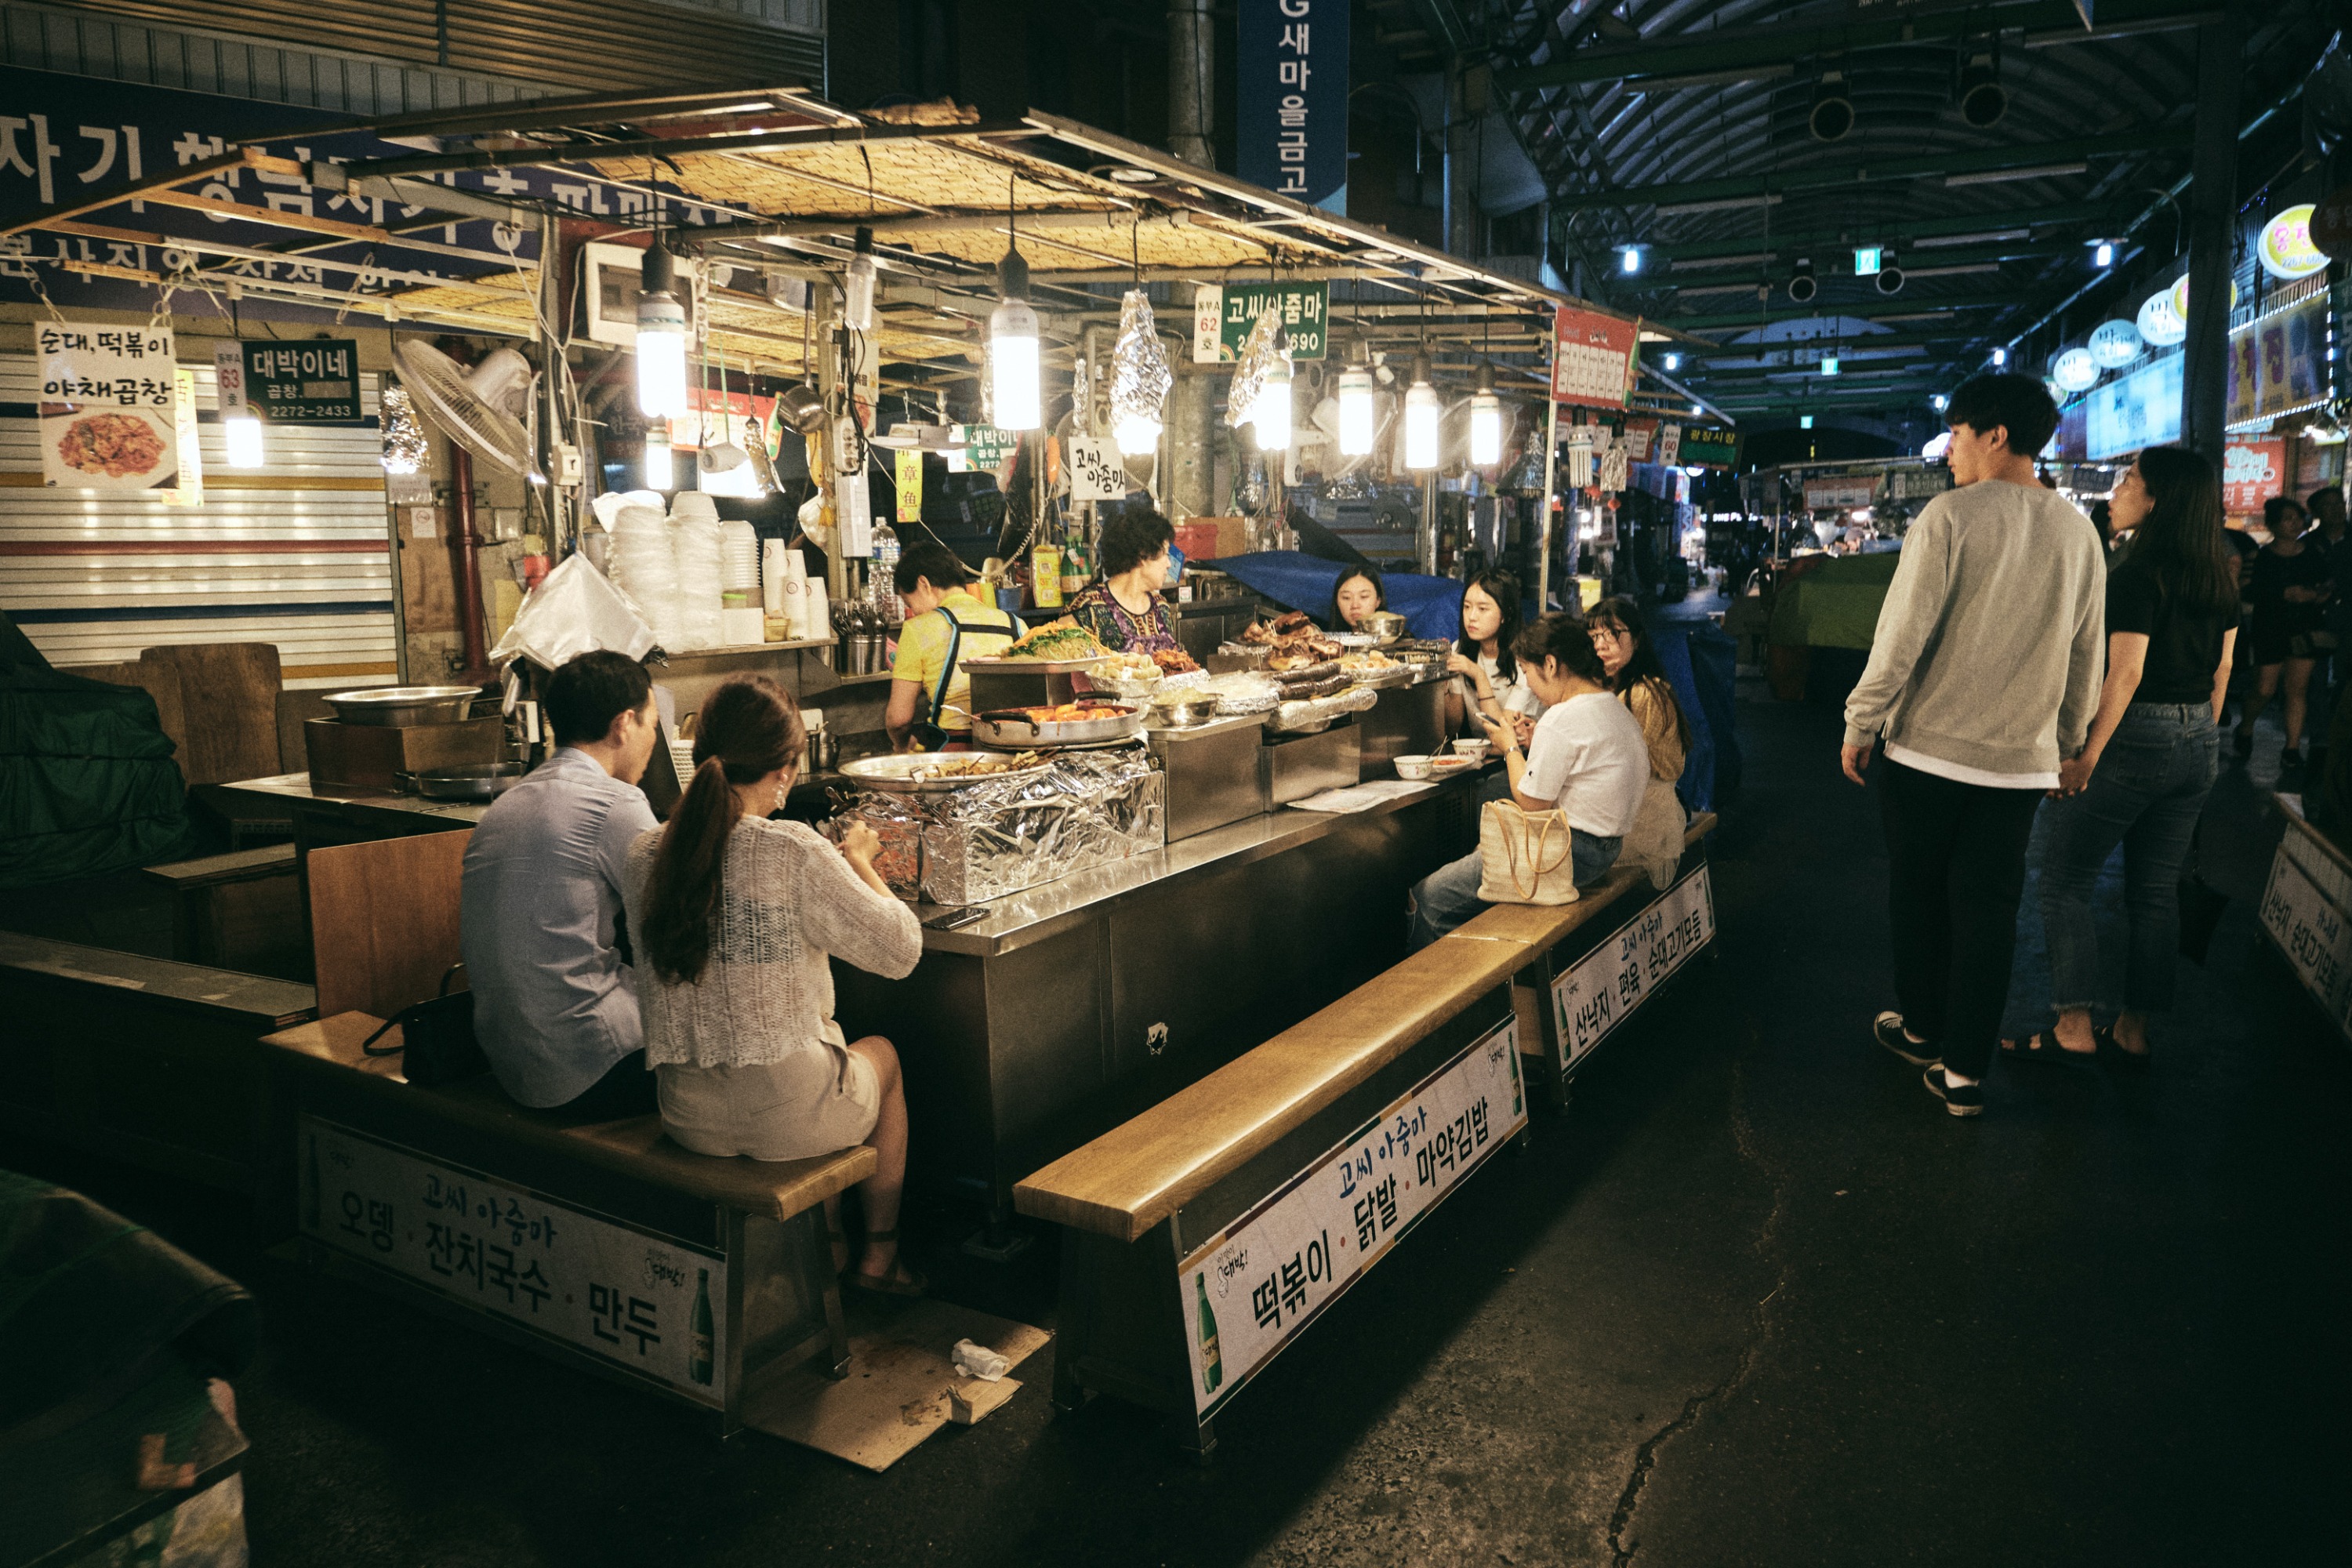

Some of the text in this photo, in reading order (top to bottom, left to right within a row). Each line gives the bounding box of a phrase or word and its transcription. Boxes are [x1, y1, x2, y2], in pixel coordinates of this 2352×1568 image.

[1200, 318, 1217, 332] 62
[41, 328, 169, 359] 순대,떡볶이
[220, 368, 240, 389] 63
[253, 350, 349, 379] 대박이네
[44, 377, 172, 405] 야채곱창
[270, 405, 350, 417] 2272-2433
[1076, 448, 1101, 468] 고씨
[1664, 440, 1677, 451] 60
[902, 450, 917, 507] 章鱼
[1087, 464, 1124, 493] 아줌마
[1621, 910, 1663, 962] 고씨 아줌마
[1575, 909, 1701, 1048] 산낙지 편육 순대고기모듬
[1339, 1105, 1428, 1200] 고씨 아줌마
[423, 1174, 557, 1248] 고씨 아줌마
[1253, 1096, 1490, 1330] 떡볶이 닭발 마약김밥
[339, 1190, 661, 1356] 오뎅 잔치국수 만두
[1224, 1249, 1248, 1278] 대박!
